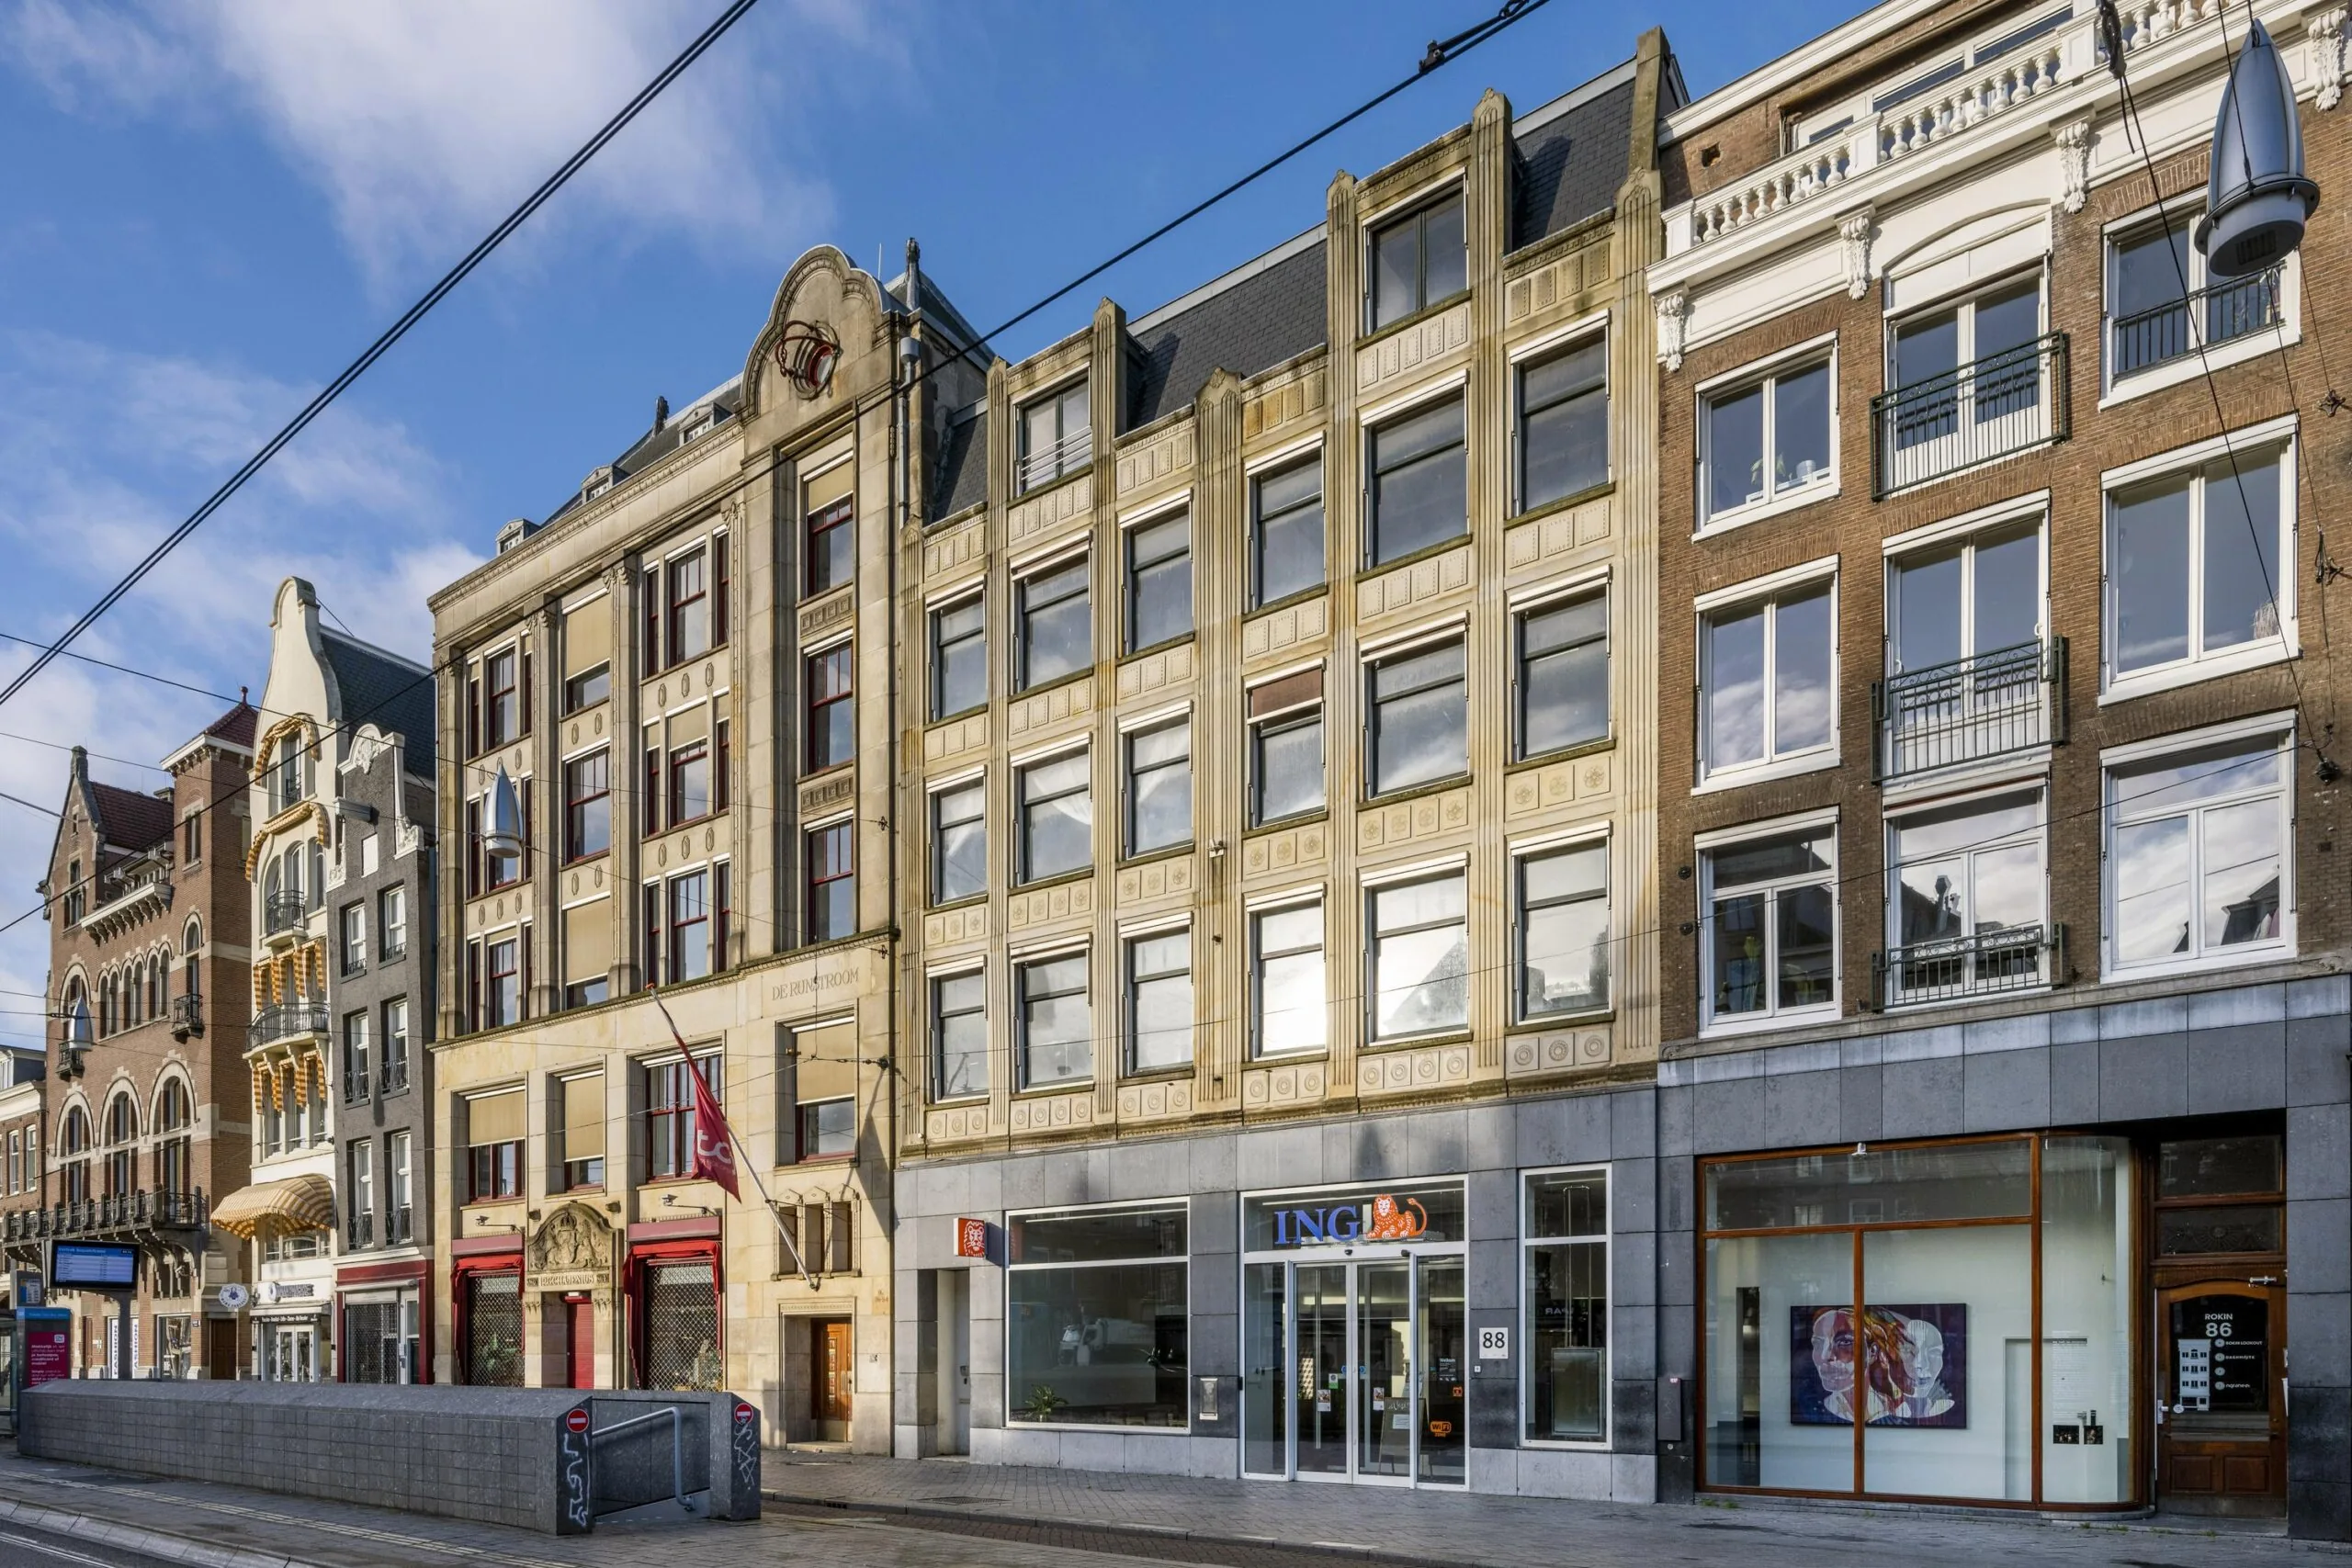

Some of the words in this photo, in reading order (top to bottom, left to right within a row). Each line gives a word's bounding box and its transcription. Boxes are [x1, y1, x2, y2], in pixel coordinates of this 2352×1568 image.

[772, 984, 788, 1000] DE
[1274, 1205, 1360, 1245] ING
[2205, 1322, 2233, 1337] 86
[1483, 1332, 1505, 1348] 88
